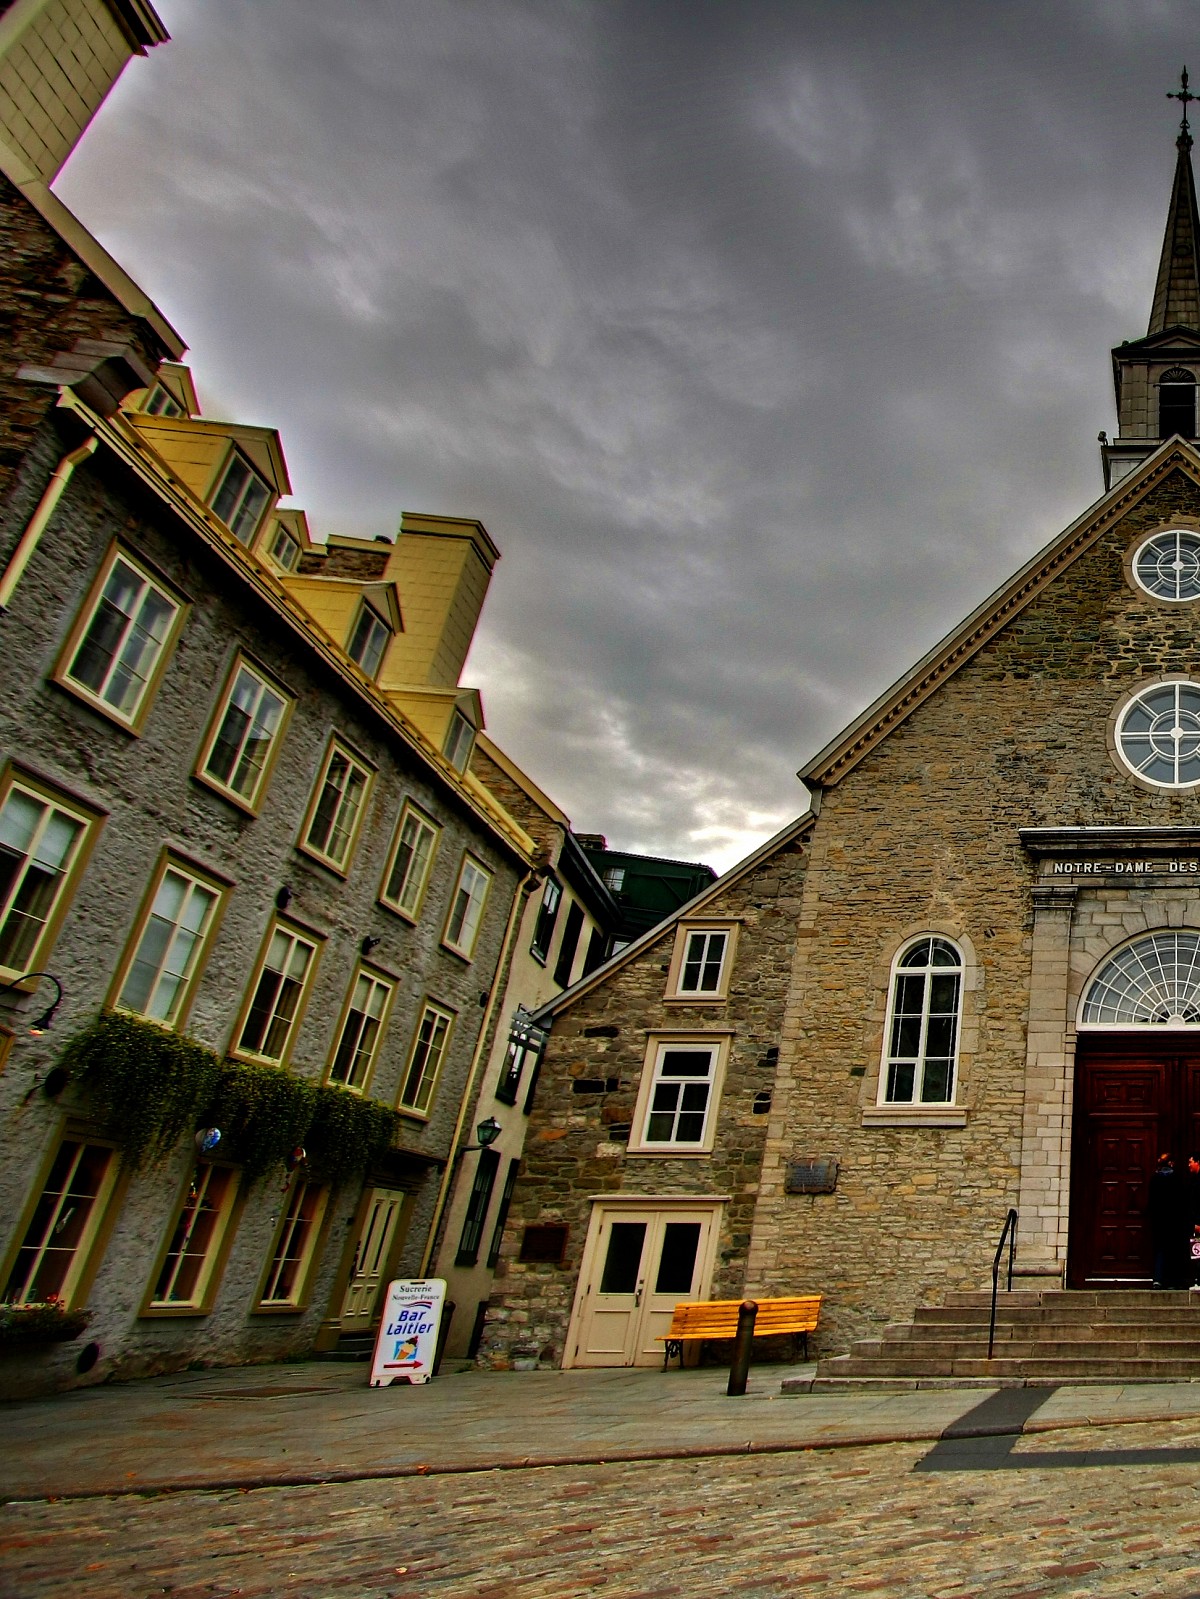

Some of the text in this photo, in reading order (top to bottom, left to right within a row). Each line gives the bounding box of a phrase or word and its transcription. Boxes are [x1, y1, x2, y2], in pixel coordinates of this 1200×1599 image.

[1053, 861, 1154, 874] NOTRE-DAME
[1169, 861, 1198, 873] DES
[399, 1284, 432, 1293] Sucrerie
[398, 1310, 427, 1322] Bar
[386, 1323, 434, 1335] Laitier
